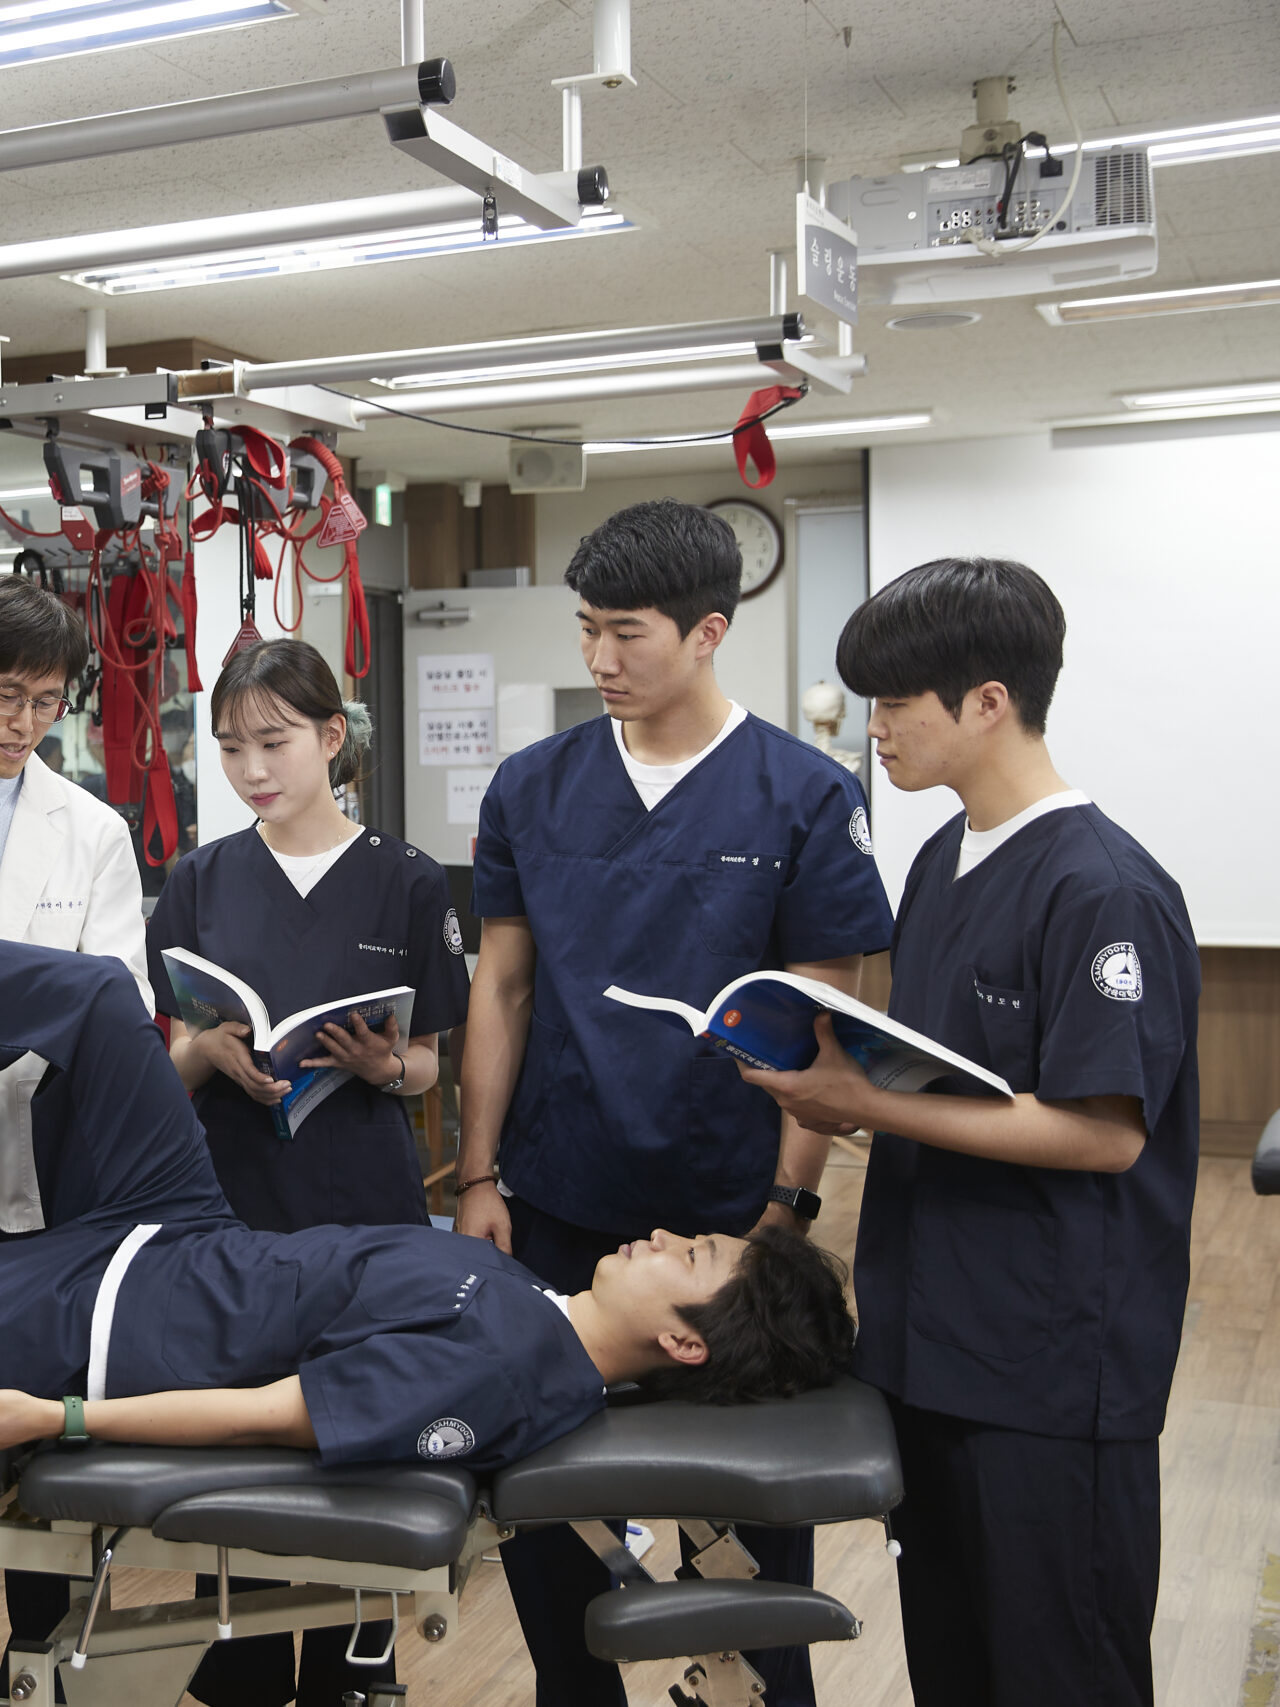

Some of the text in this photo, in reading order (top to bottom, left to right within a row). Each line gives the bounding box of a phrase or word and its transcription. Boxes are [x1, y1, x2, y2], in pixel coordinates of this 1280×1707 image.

[810, 237, 857, 292] 슬링운동
[1094, 944, 1127, 982] SAHMYOOK
[432, 1420, 472, 1441] SAHMYOOK
